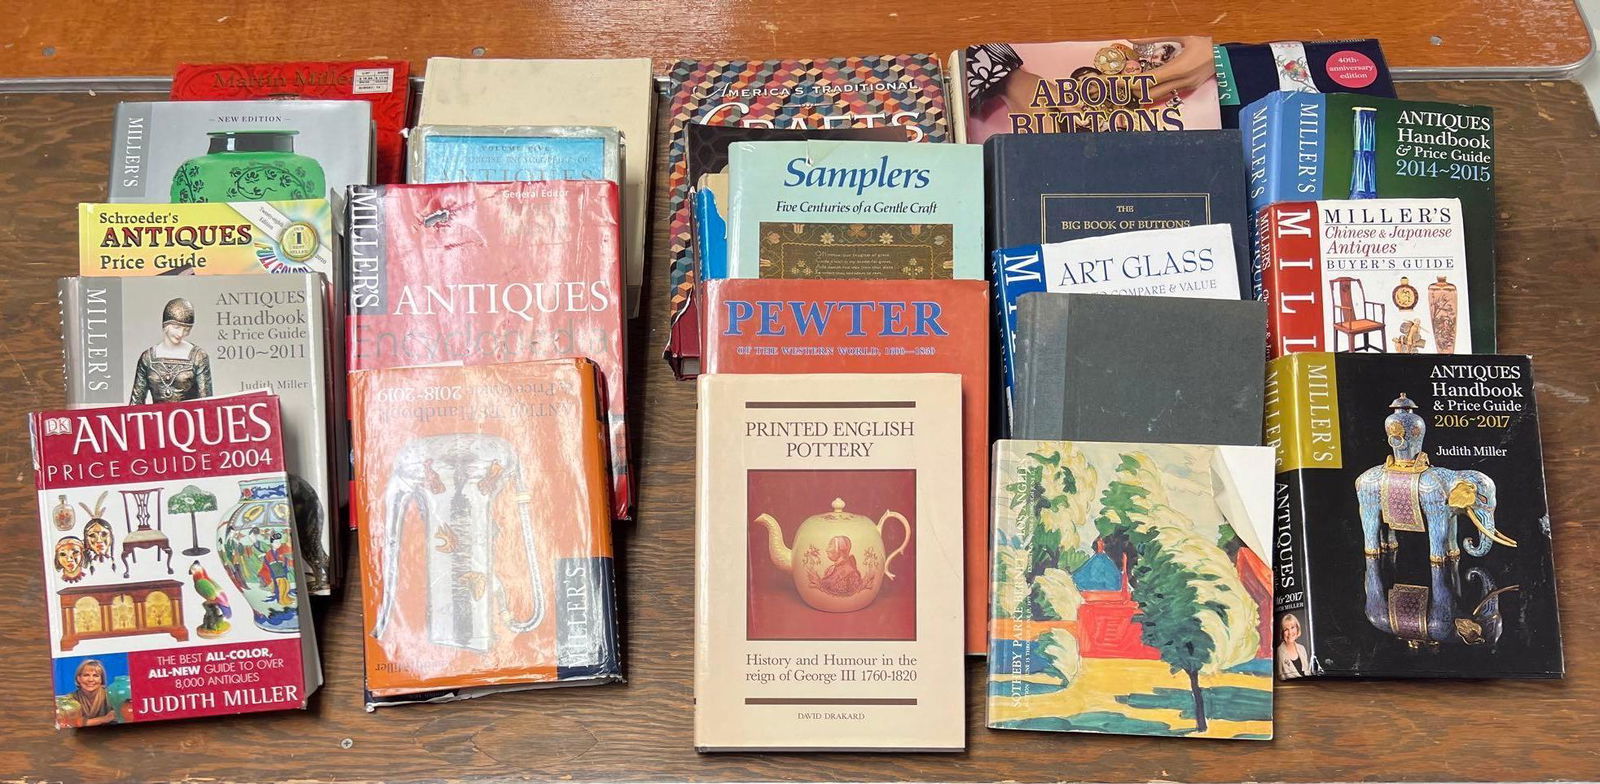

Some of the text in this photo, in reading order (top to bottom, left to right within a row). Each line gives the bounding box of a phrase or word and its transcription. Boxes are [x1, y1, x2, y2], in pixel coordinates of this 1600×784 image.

[213, 71, 287, 89] Martin
[692, 82, 921, 99] AMERICA'S TRADITIONAL
[1031, 75, 1157, 107] ABOUT
[217, 115, 282, 123] NEW EDITION
[1008, 107, 1184, 133] BUTTONS
[1397, 110, 1491, 131] ANTIQUES
[1398, 128, 1491, 149] Handbook
[125, 117, 145, 188] MILLER'S
[1250, 105, 1268, 199] MILLER'S
[1297, 103, 1319, 194] MILLER'S
[1395, 144, 1491, 164] & Price Guide
[783, 155, 931, 196] Samplers
[502, 188, 570, 198] General Editor
[776, 200, 939, 215] Five Centuries of a Gentle Craft
[1116, 205, 1134, 213] THE
[1324, 207, 1451, 224] MILLER'S
[99, 211, 179, 225] Schroeder's
[1061, 220, 1191, 230] BIG BOOK OF BUTTONS
[100, 223, 253, 250] ANTIQUES
[1325, 225, 1452, 240] Chinese & Japanese
[351, 190, 379, 308] MILLER'S
[1326, 240, 1397, 257] Antiques
[100, 253, 207, 269] Price Guide
[1058, 248, 1215, 287] ART GLASS
[1327, 258, 1454, 270] BUYER'S GUIDE
[1168, 283, 1178, 292] &
[1179, 280, 1217, 291] VALUE
[216, 290, 305, 307] ANTIQUES
[393, 280, 610, 322] ANTIQUES
[217, 311, 306, 326] Handbook
[723, 300, 950, 338] PEWTER
[86, 288, 108, 392] MILLER'S
[217, 328, 306, 341] & Price Guide
[737, 346, 752, 355] OF
[754, 346, 778, 355] THE
[781, 346, 834, 355] WESTERN
[1430, 364, 1521, 383] ANTIQUES
[240, 379, 309, 392] Judith Miller
[514, 383, 554, 397] Price
[1432, 382, 1523, 398] Handbook
[1307, 364, 1333, 463] MILLER'S
[1433, 400, 1522, 412] & Price Guide
[73, 402, 272, 456] ANTIQUES
[745, 421, 915, 437] PRINTED ENGLISH
[786, 442, 875, 457] POTTERY
[1436, 446, 1508, 457] Judith Miller
[48, 448, 273, 482] PRICE GUIDE 2004
[1016, 514, 1028, 537] LOS
[1275, 481, 1295, 588] ANTIQUES
[563, 566, 588, 669] MILLER'S
[1013, 607, 1024, 646] PARKE
[157, 648, 274, 665] THE BEST ALL-COLOR,
[746, 653, 918, 668] History and Humour in the
[147, 658, 284, 679] ALL-NEW GUIDE TO OVER
[746, 669, 918, 685] reign of George III 1760-1820
[175, 672, 260, 689] 8,000 ANTIQUES
[1012, 651, 1022, 708] SOTHEBY
[139, 685, 299, 714] JUDITH MILLER
